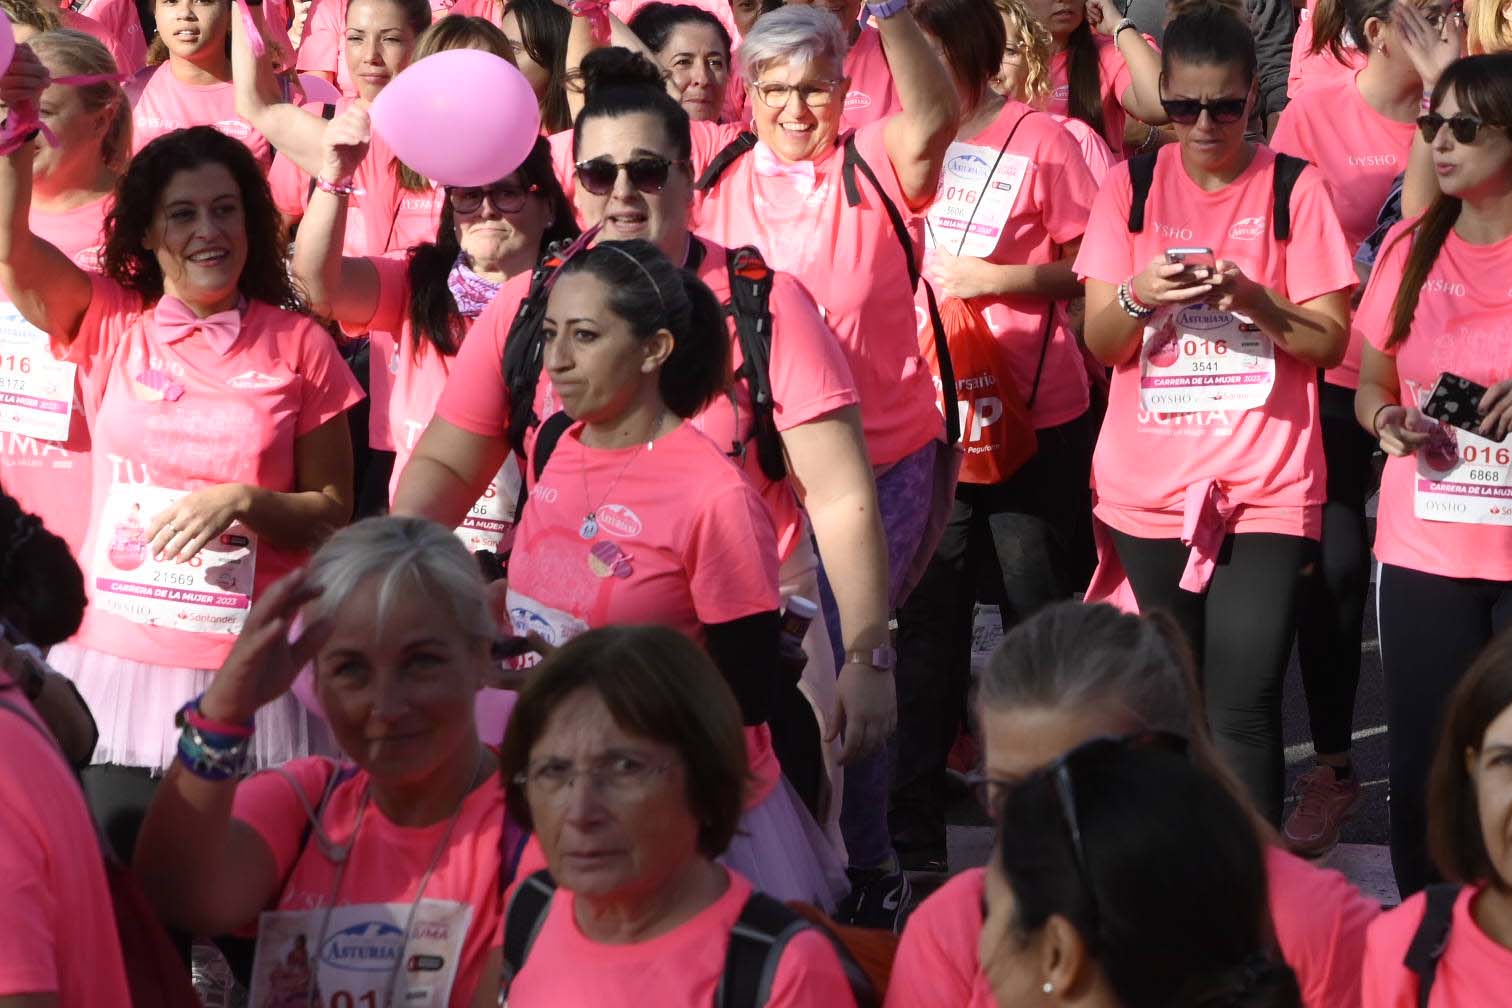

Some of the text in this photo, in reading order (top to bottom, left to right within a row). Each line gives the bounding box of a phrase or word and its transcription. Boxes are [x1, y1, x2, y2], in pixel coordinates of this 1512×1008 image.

[946, 186, 977, 205] 016
[1181, 310, 1231, 324] ASTURIANA
[1184, 339, 1228, 357] 016
[1192, 361, 1219, 373] 3541
[1154, 377, 1191, 387] CARRERA
[1192, 377, 1203, 385] DE
[1204, 377, 1214, 385] LA
[1215, 375, 1241, 385] MUJER
[1151, 392, 1192, 404] OYSHO
[1463, 445, 1511, 466] 016
[1470, 469, 1499, 482] 6868
[1429, 482, 1467, 493] CARRERA
[1468, 486, 1481, 495] DE
[1482, 487, 1494, 496] LA
[1425, 499, 1467, 513] OYSHO
[463, 518, 505, 532] LA MUJER
[153, 570, 194, 586] 21569
[111, 582, 237, 606] CARRERA DE LA MUJER 2023
[189, 612, 238, 625] Santander
